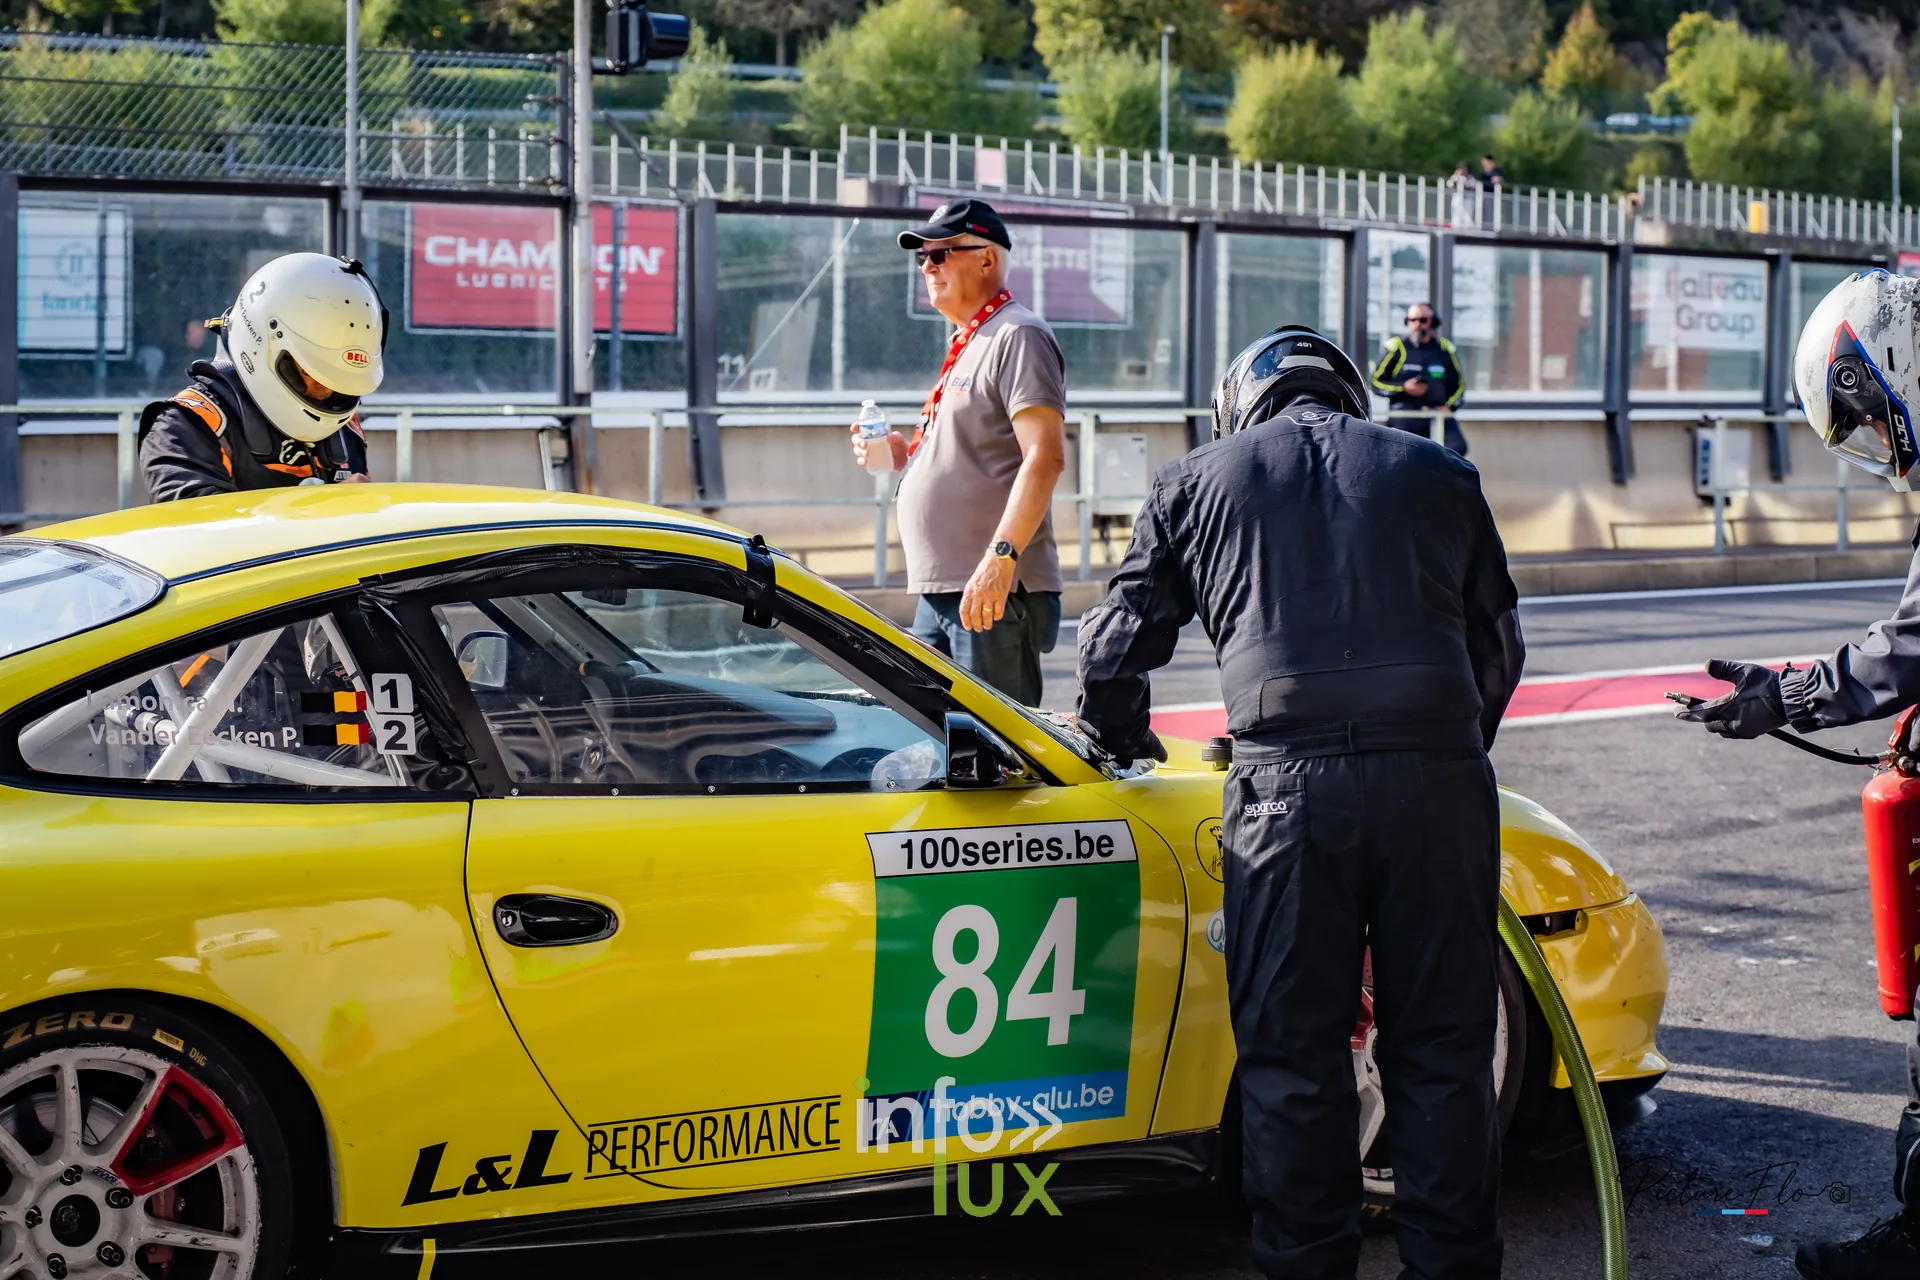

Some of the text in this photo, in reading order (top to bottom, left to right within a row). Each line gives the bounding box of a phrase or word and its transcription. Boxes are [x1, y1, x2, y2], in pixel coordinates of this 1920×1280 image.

[424, 235, 661, 275] CHAMON
[249, 281, 266, 305] 2
[1677, 303, 1755, 340] Group
[347, 352, 368, 364] BELL
[1893, 414, 1912, 452] HJC
[380, 678, 399, 709] 1
[88, 723, 181, 747] Vander
[282, 726, 301, 748] P.
[384, 720, 408, 751] 2
[1244, 801, 1287, 817] sparco
[900, 829, 1115, 870] 100series.be
[924, 896, 1087, 1058] 84
[3, 1011, 135, 1050] ZERO
[189, 1047, 208, 1067] DHG
[401, 1101, 841, 1207] L&L PERFORMANCE
